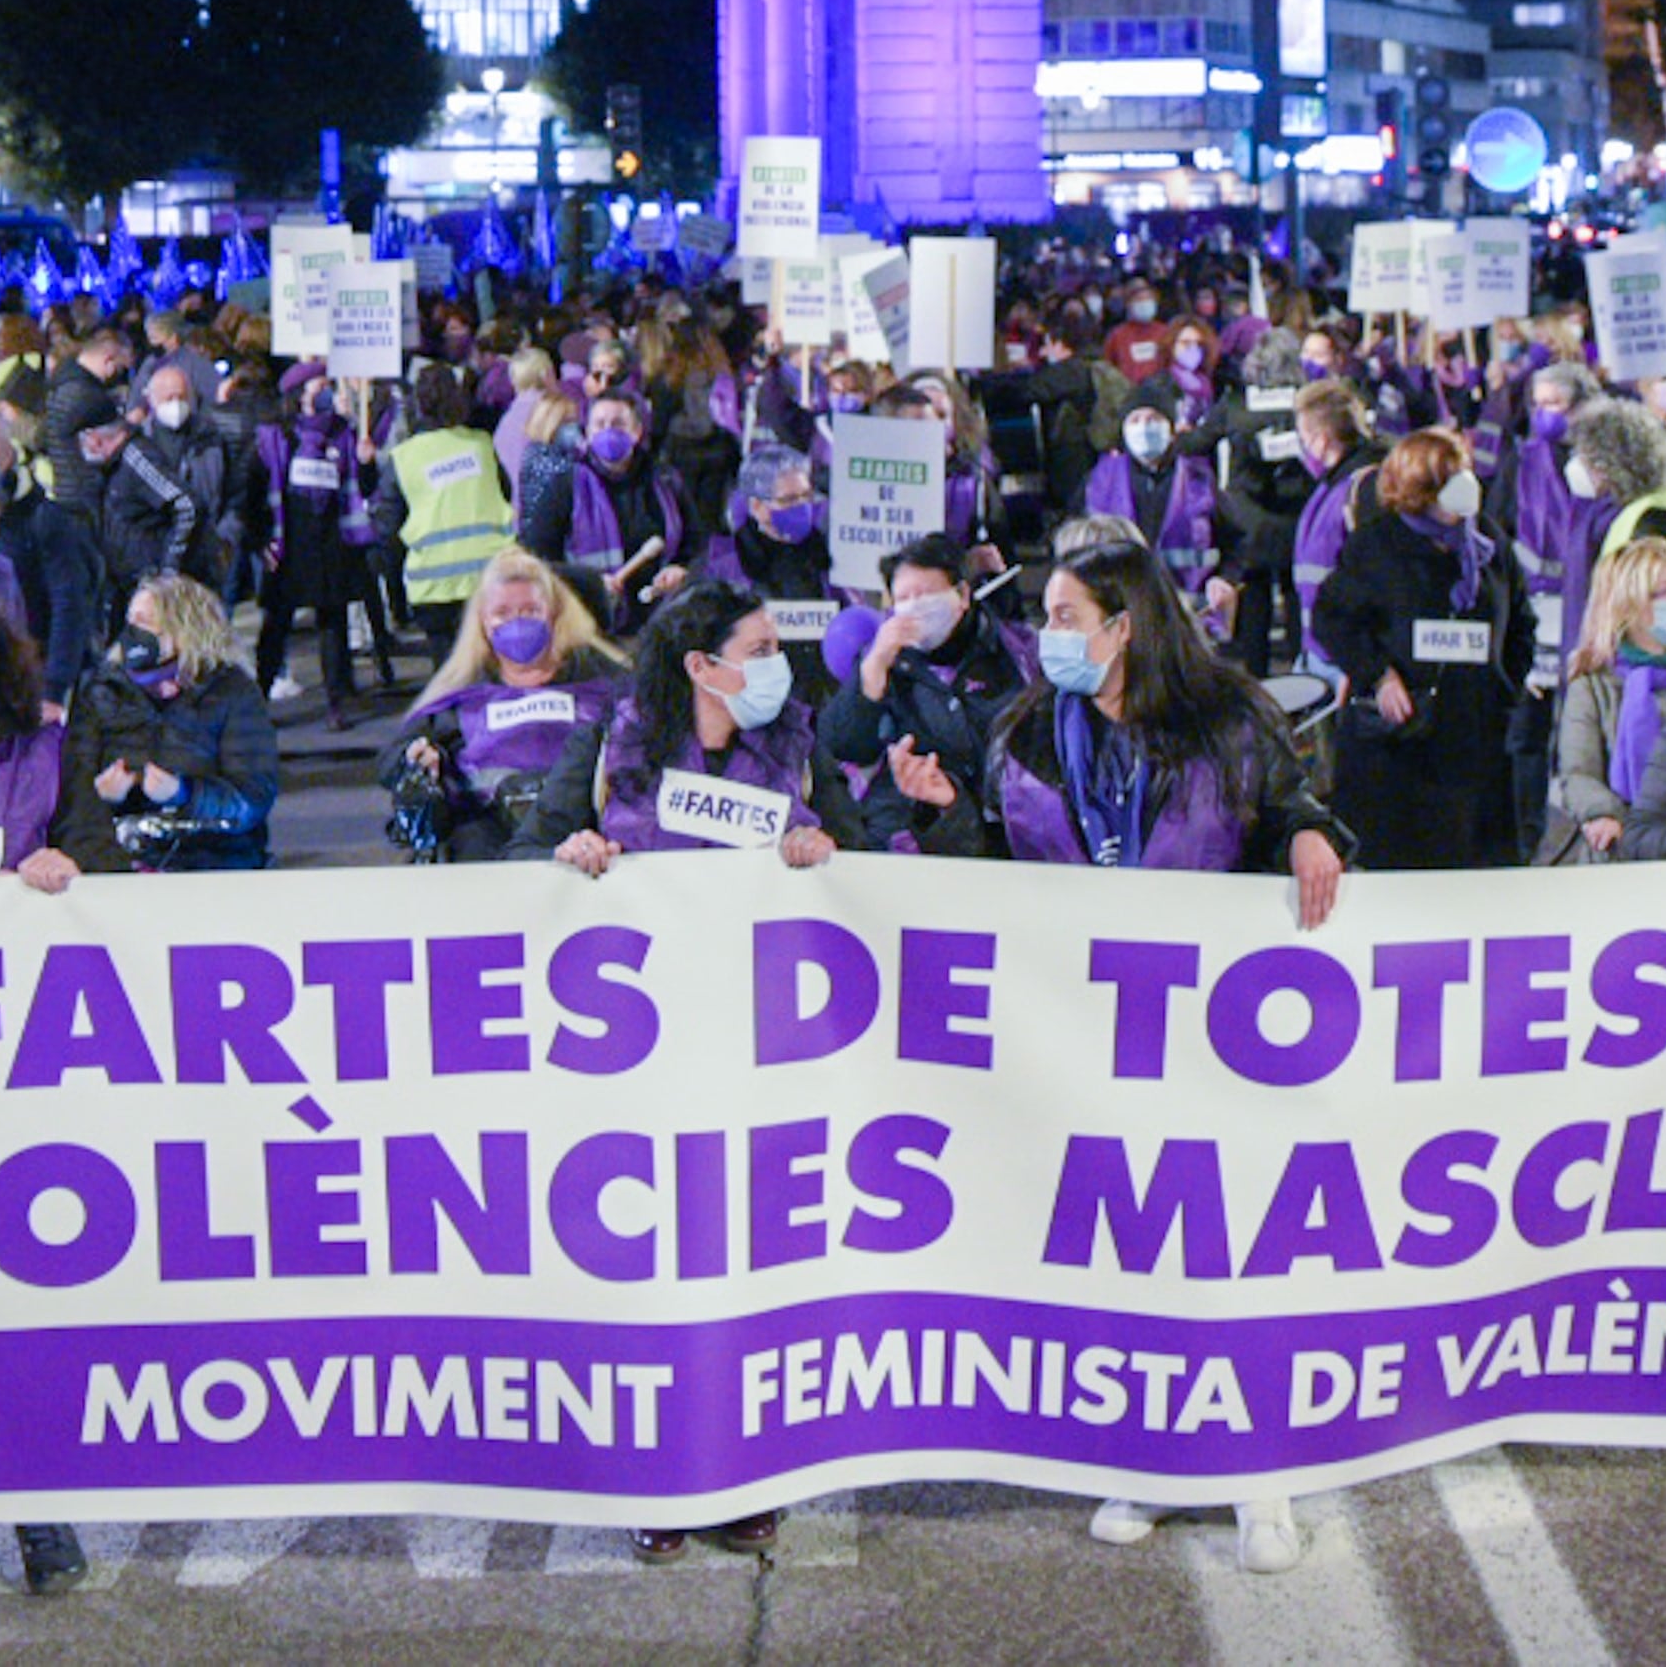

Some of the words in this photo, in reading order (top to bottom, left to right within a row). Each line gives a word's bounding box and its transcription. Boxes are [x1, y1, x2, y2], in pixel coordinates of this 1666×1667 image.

[495, 698, 569, 722] #FARTES
[668, 786, 779, 836] #FARTES
[752, 918, 997, 1071] DE
[81, 1355, 674, 1449] MOVIMENT
[742, 1328, 1253, 1437] FEMINISTA
[1288, 1343, 1406, 1428] DE
